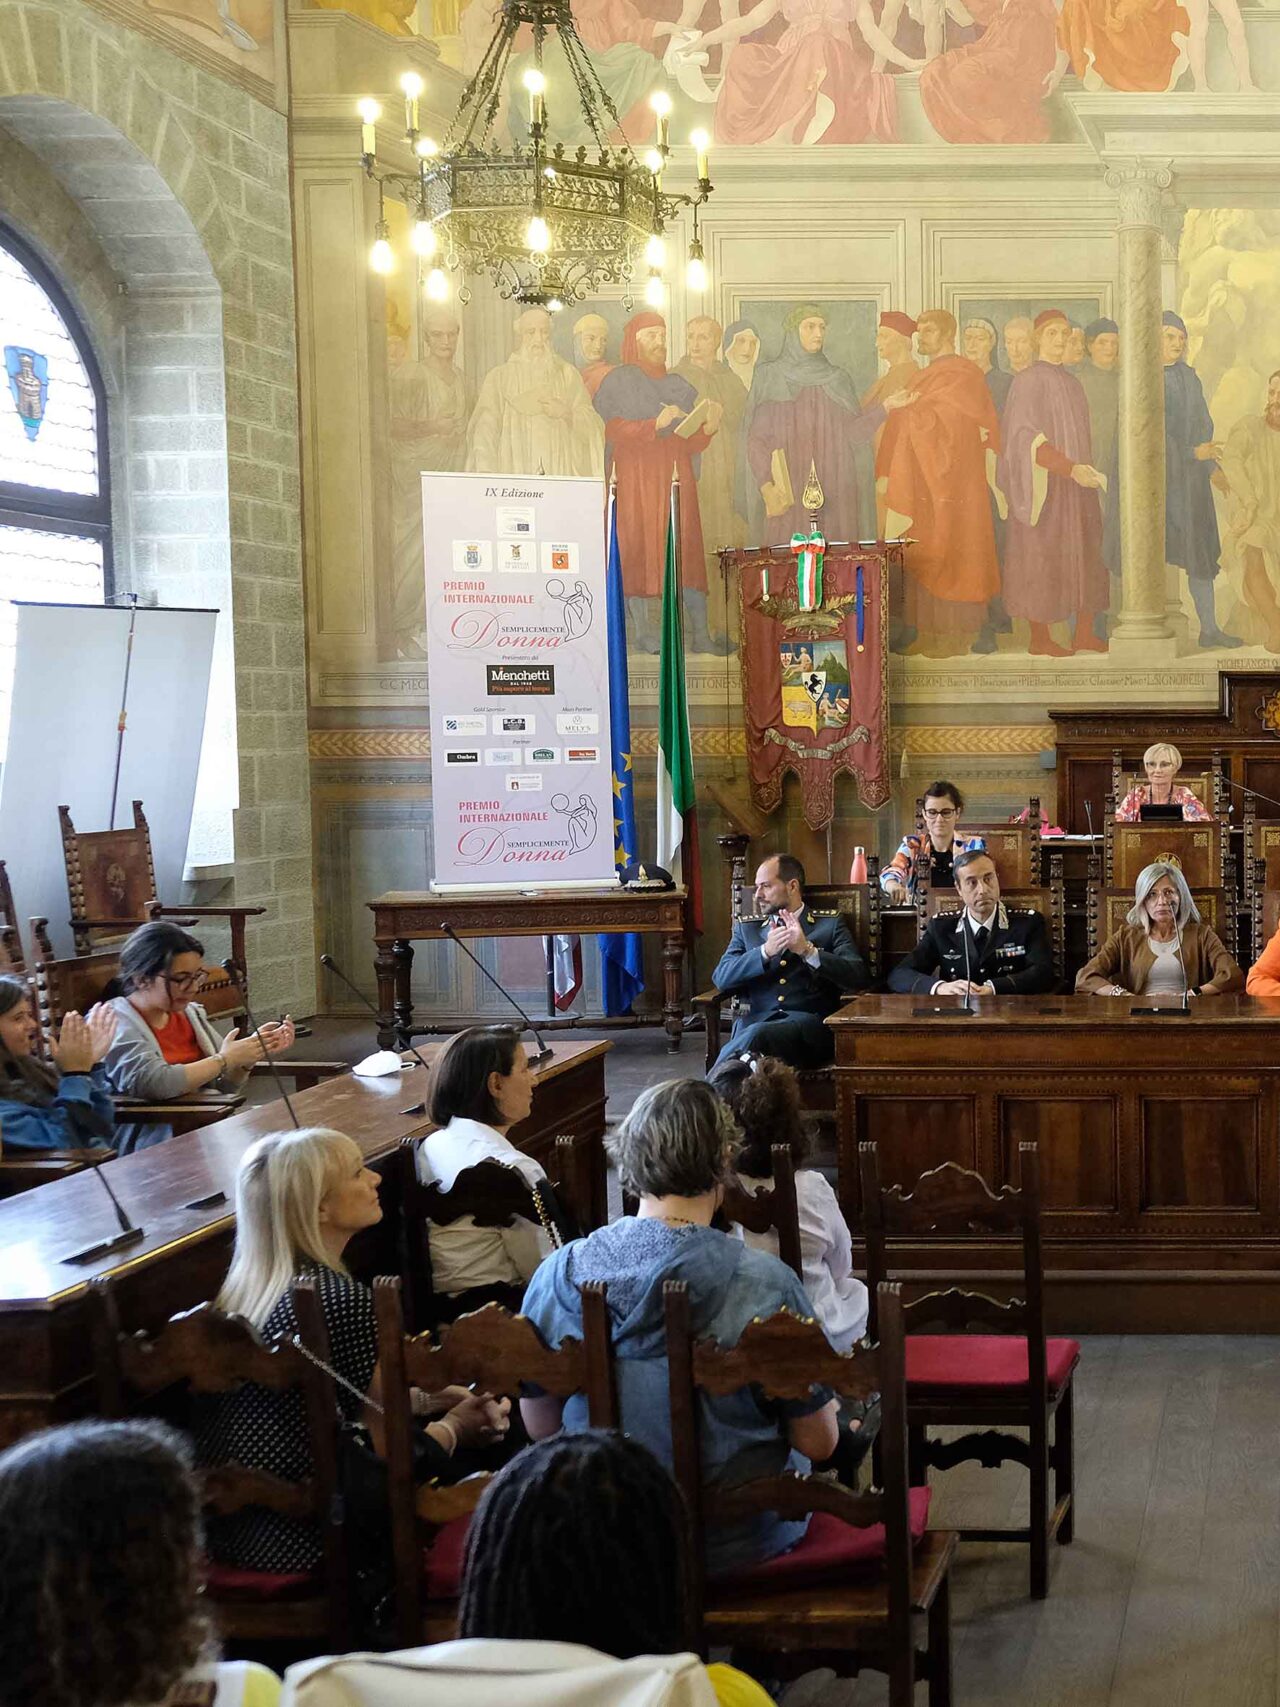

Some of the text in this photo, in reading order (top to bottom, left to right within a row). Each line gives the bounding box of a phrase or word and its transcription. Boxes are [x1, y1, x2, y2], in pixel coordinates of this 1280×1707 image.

[485, 487, 545, 499] IX Edizione
[443, 581, 485, 591] PREMIO
[444, 594, 535, 604] INTERNAZIONALE
[447, 609, 562, 649] Donna
[491, 669, 550, 681] Menchetti
[459, 801, 500, 811] PREMIO
[459, 812, 548, 823] INTERNAZIONALE
[453, 827, 567, 867] Donna
[507, 840, 569, 848] SEMPLICEMENTE
